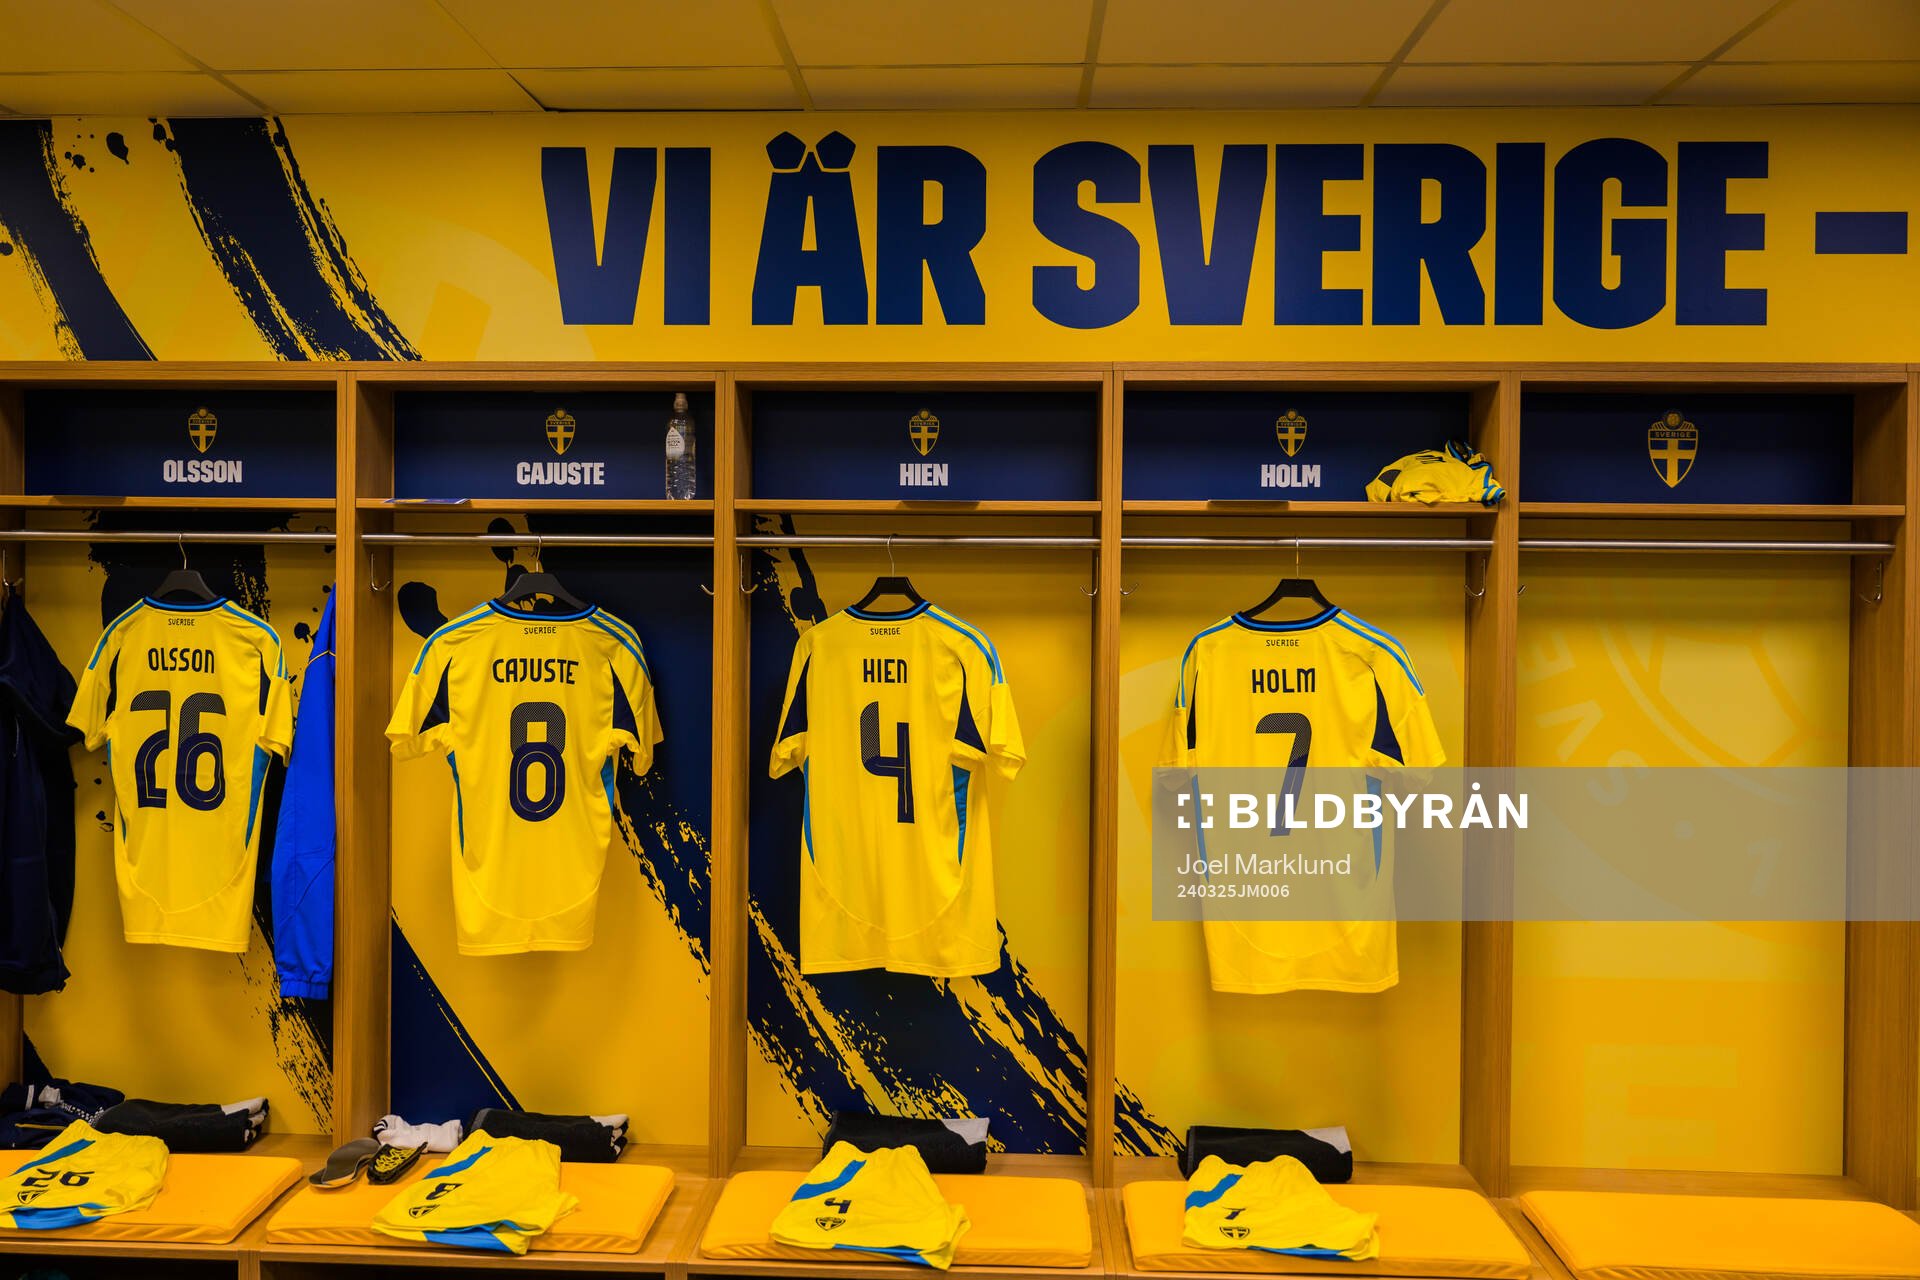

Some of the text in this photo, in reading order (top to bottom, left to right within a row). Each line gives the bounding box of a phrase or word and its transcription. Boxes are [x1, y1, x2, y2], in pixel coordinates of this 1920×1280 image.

[541, 147, 711, 325] VI
[752, 131, 987, 325] ÄR
[1032, 137, 1769, 331] SVERIGE
[163, 460, 242, 483] OLSSON
[516, 462, 605, 485] CAJUSTE
[900, 463, 949, 486] HIEN
[1260, 464, 1321, 488] HOLM
[168, 618, 195, 626] SVERIGE
[523, 626, 557, 635] SVERIGE
[870, 627, 901, 636] SVERIGE
[1265, 639, 1300, 647] SVERIGE
[147, 647, 215, 674] OLSSON
[492, 658, 579, 685] CAJUSTE
[863, 658, 908, 684] HIEN
[1251, 667, 1316, 694] HOLM
[130, 690, 226, 811] 26
[510, 701, 567, 822] 8
[860, 701, 915, 824] 4
[1255, 712, 1312, 836] 7
[21, 1168, 95, 1187] 26
[824, 1198, 852, 1214] 4
